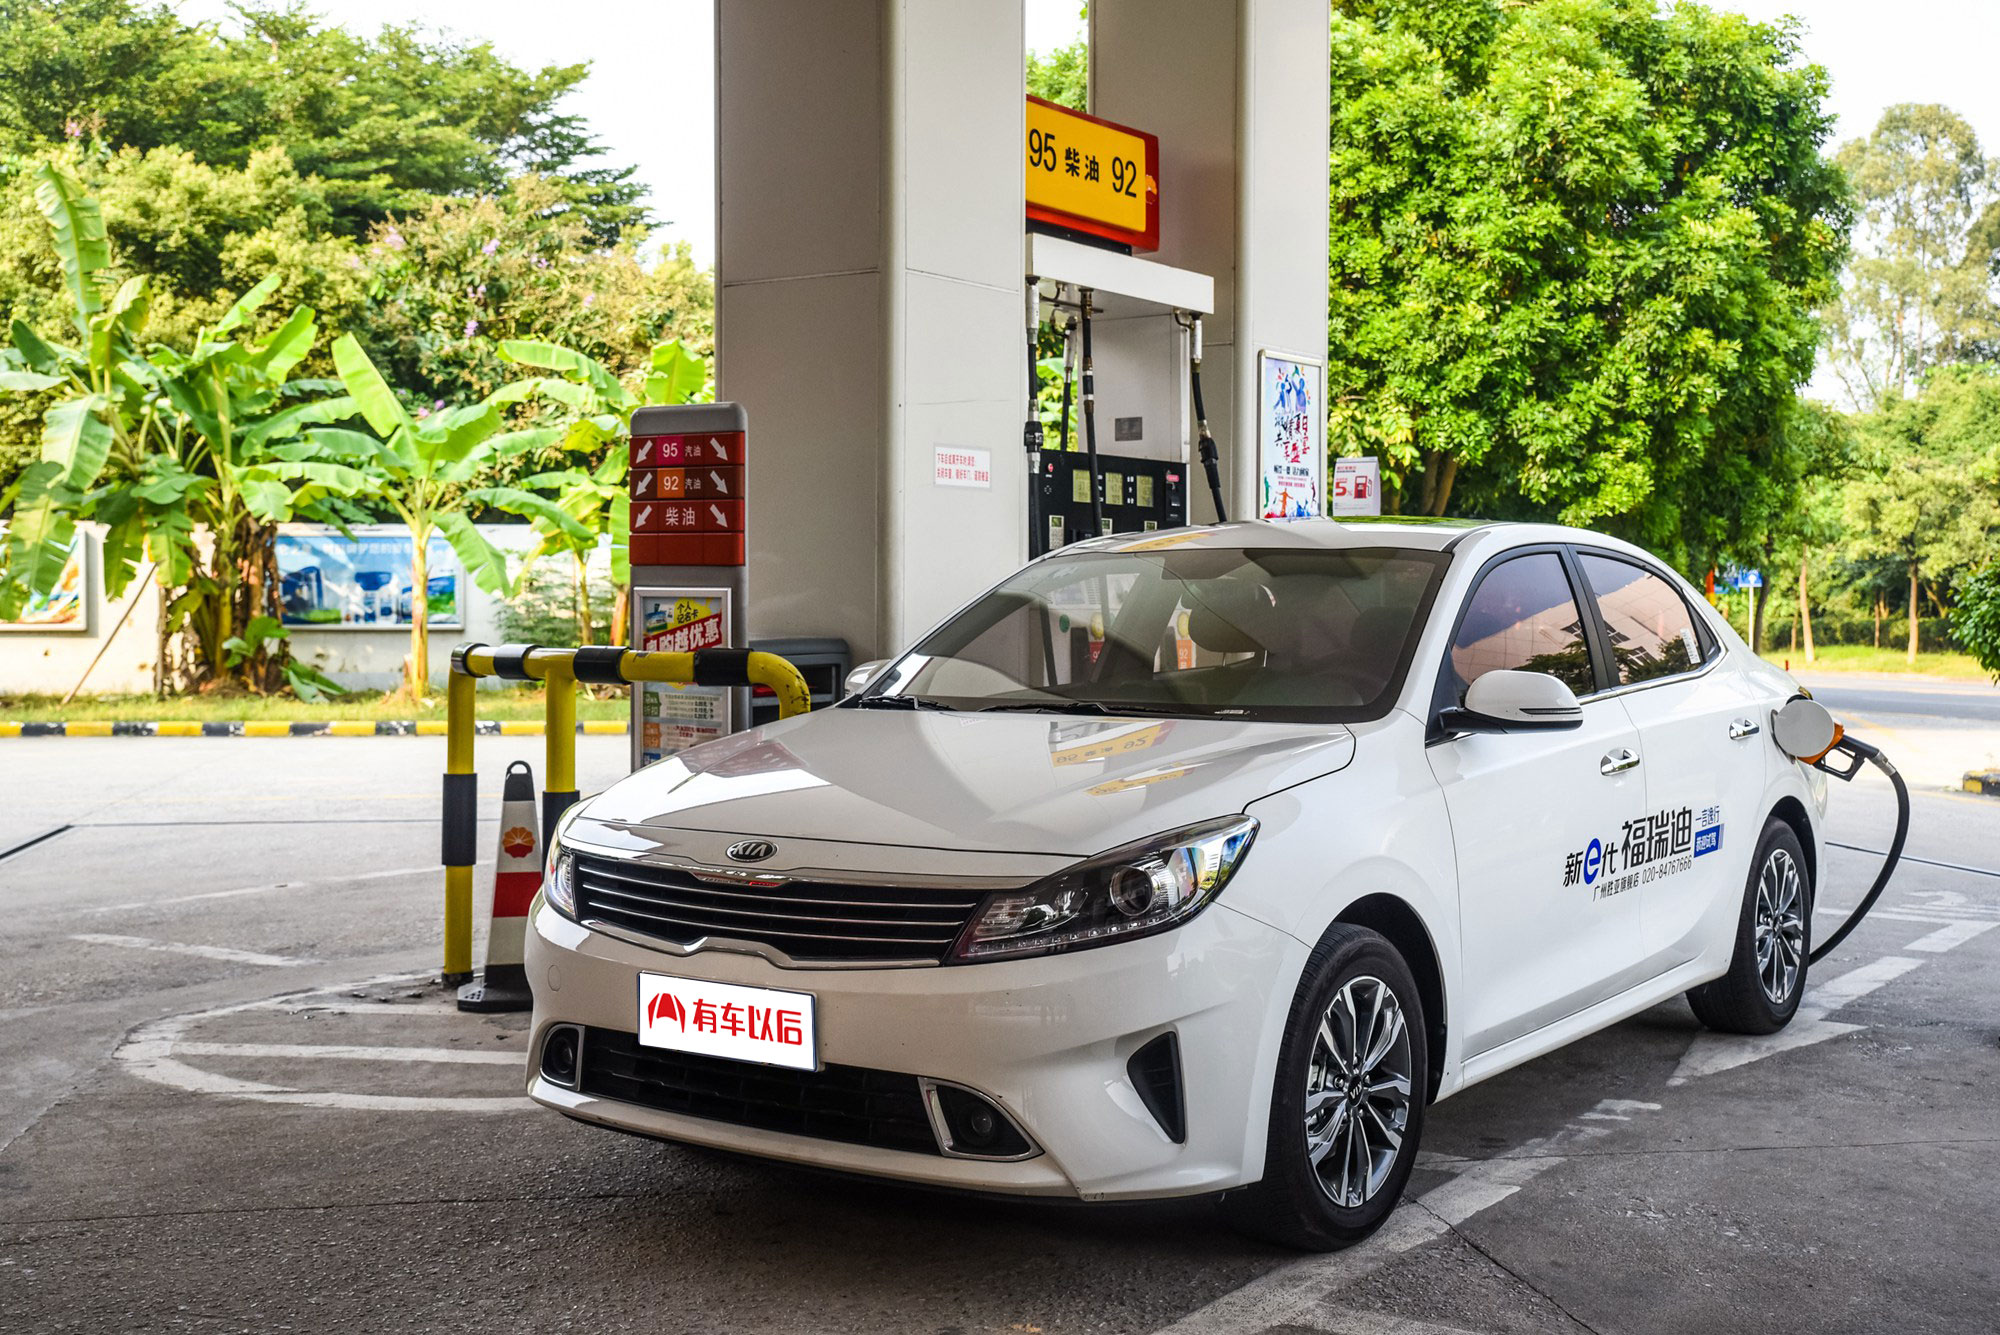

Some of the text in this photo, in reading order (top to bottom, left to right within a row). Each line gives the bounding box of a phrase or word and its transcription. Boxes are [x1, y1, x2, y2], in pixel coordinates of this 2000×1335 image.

[1029, 128, 1137, 198] 95 柴油 92
[662, 443, 701, 457] 95 汽油
[663, 476, 701, 490] 92 汽油
[665, 507, 695, 526] 柴油
[677, 601, 692, 613] 个人
[677, 609, 699, 624] 记名卡
[734, 843, 767, 857] KIA
[1563, 806, 1692, 887] 新e代 福瑞迪
[1593, 855, 1692, 902] 广州胜亚旗舰店 020-84767666
[1350, 1082, 1363, 1099] KIA
